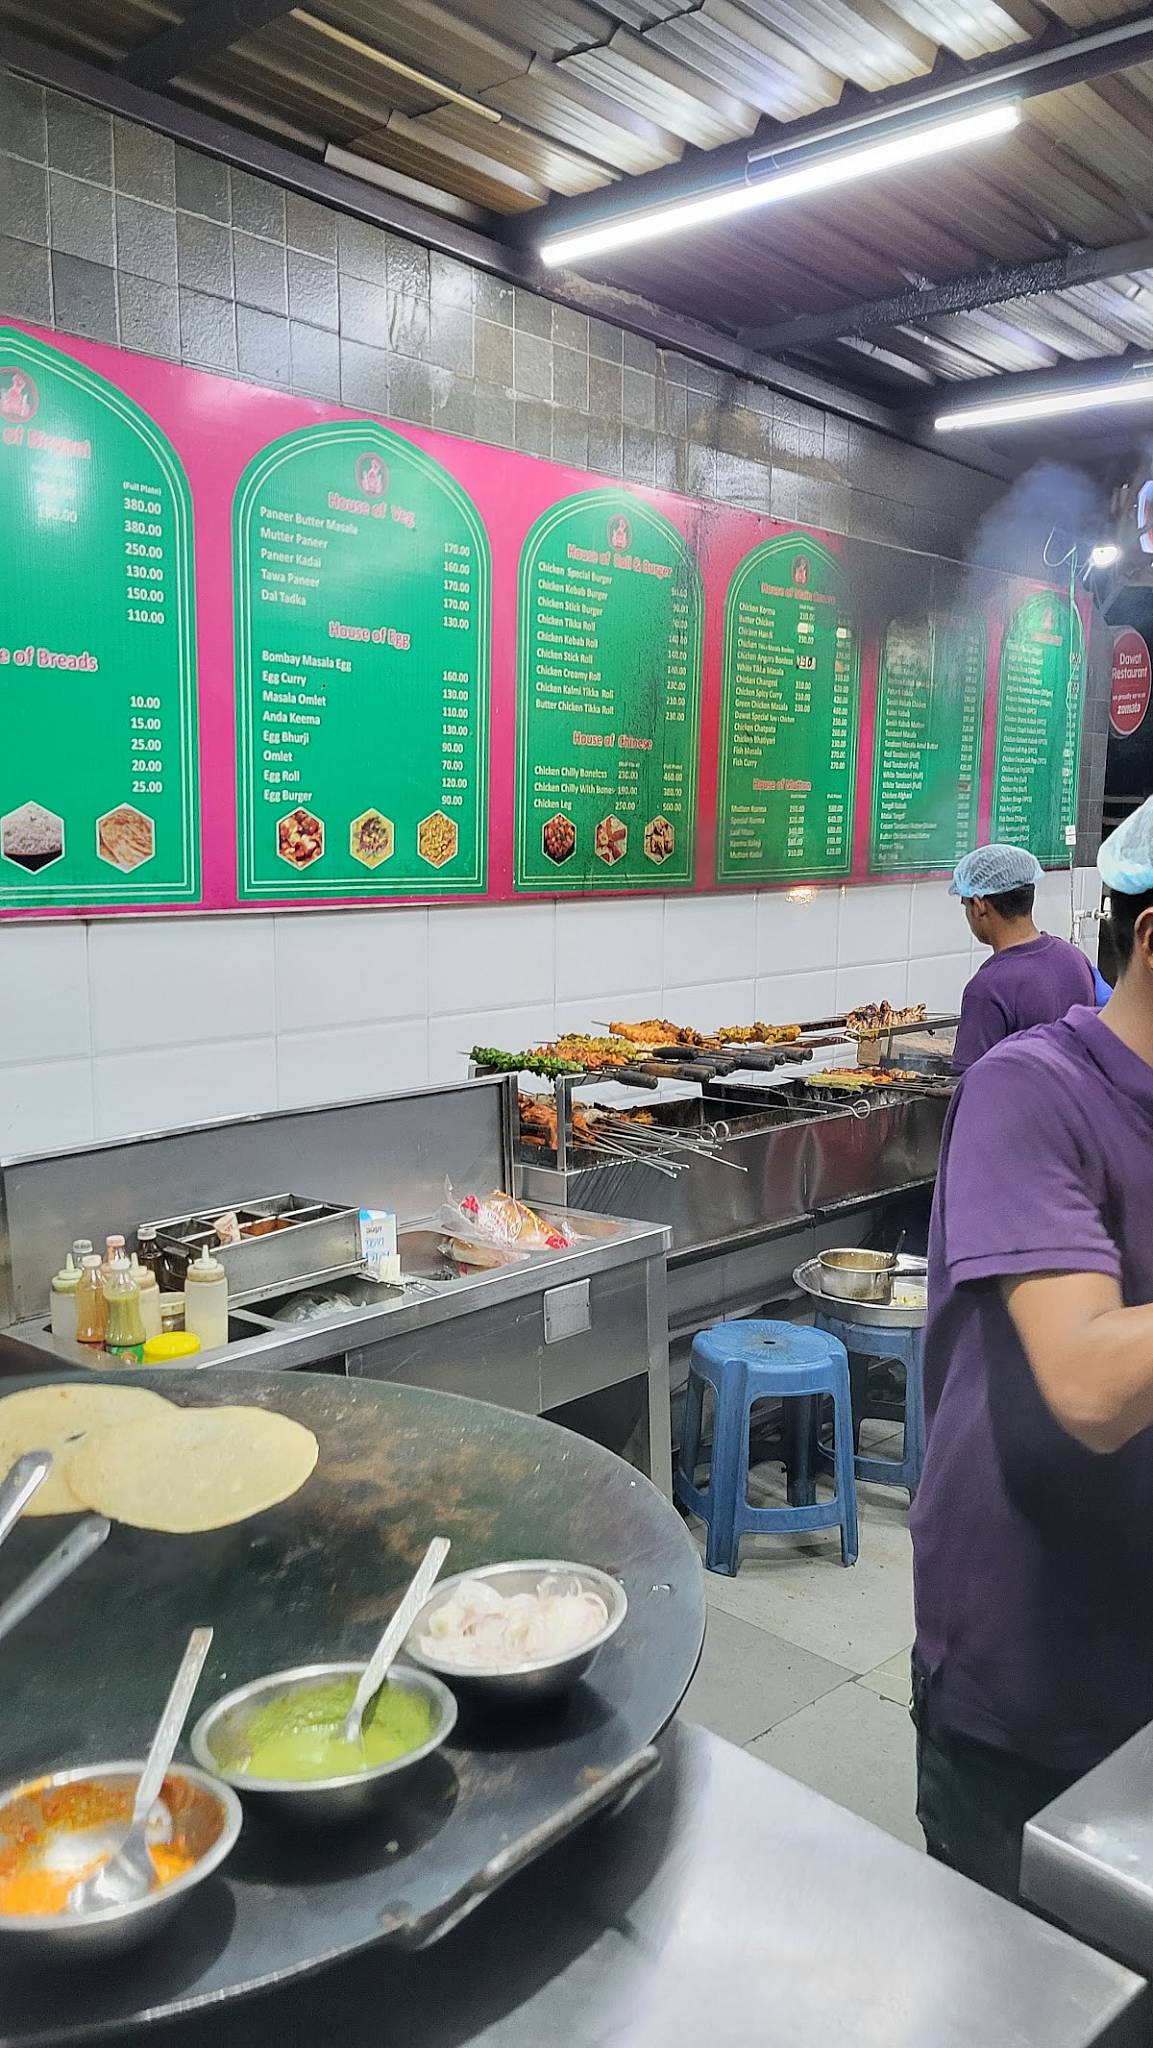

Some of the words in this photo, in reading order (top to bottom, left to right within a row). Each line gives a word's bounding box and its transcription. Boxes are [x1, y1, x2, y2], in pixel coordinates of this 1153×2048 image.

[123, 498, 161, 515] 380.00
[327, 491, 370, 516] House
[371, 503, 386, 518] of
[391, 505, 416, 529] Veg
[124, 520, 162, 536] 380.00
[260, 506, 294, 523] Paneer
[295, 512, 324, 529] Butter
[326, 517, 358, 535] Masala
[260, 527, 294, 545] Mutter
[296, 533, 328, 549] Paneer
[125, 542, 162, 559] 250.00
[443, 542, 470, 557] 170.00
[261, 548, 294, 564] Paneer
[295, 553, 322, 568] Kadai
[567, 543, 599, 564] House
[599, 551, 611, 566] of
[642, 558, 673, 580] Burger
[126, 564, 163, 580] 130.00
[444, 561, 470, 575] 160.00
[538, 561, 565, 575] Chicken
[567, 567, 591, 581] Special
[591, 571, 613, 585] Burger
[261, 568, 286, 583] Tawa
[288, 572, 320, 588] Paneer
[443, 579, 470, 593] 170.00
[127, 586, 164, 602] 150.00
[261, 589, 279, 601] Dal
[280, 591, 307, 606] Tadka
[538, 579, 564, 592] Chicken
[586, 588, 608, 601] Burger
[443, 598, 470, 612] 170.00
[537, 596, 564, 609] Chicken
[564, 601, 581, 613] Stick
[581, 603, 603, 617] Burger
[127, 608, 164, 624] 110.00
[443, 616, 469, 630] 130.00
[537, 614, 563, 627] Chicken
[564, 618, 582, 629] Tikka
[582, 621, 596, 632] Roll
[328, 621, 370, 642] House
[371, 628, 386, 644] of
[388, 629, 410, 649] Egg
[537, 631, 563, 644] Chicken
[585, 637, 599, 649] Roll
[13, 647, 34, 665] of
[37, 649, 98, 672] Breads
[262, 650, 301, 667] Bombay
[302, 655, 334, 669] Masala
[336, 658, 352, 672] Egg
[536, 648, 563, 661] Chicken
[563, 651, 580, 663] Stick
[580, 653, 593, 665] Roll
[1119, 652, 1142, 665] Dawat
[262, 671, 279, 685] Egg
[281, 673, 307, 687] Curry
[443, 671, 469, 684] 160.00
[536, 665, 562, 678] Chicken
[563, 668, 588, 681] Creamy
[589, 671, 602, 681] Roll
[1112, 666, 1147, 680] Restaurant
[263, 690, 297, 705] Masala
[298, 693, 326, 706] Omlet
[442, 689, 468, 701] 130.00
[536, 682, 562, 695] Chicken
[582, 687, 600, 698] Tikka
[601, 689, 614, 699] Roll
[130, 696, 160, 709] 10.00
[535, 699, 557, 710] Butter
[558, 701, 584, 713] Chicken
[584, 704, 601, 715] Tikka
[601, 706, 614, 715] Roll
[1117, 702, 1140, 715] zomato
[263, 711, 288, 723] Anda
[289, 712, 321, 725] Keema
[442, 706, 468, 719] 110.00
[131, 717, 161, 730] 15.00
[442, 724, 468, 736] 130.00
[131, 738, 161, 751] 25.00
[263, 730, 280, 744] Egg
[282, 731, 310, 746] Bhurji
[573, 730, 603, 747] House
[603, 733, 615, 747] of
[618, 735, 653, 751] Chinese
[442, 742, 464, 754] 90.00
[263, 750, 293, 763] Omlet
[131, 760, 162, 772] 20.00
[442, 760, 464, 771] 70.00
[534, 765, 560, 777] Chicken
[561, 767, 579, 778] Chilly
[579, 768, 608, 779] Boneless
[263, 769, 280, 783] Egg
[282, 770, 300, 782] Roll
[442, 777, 467, 789] 120.00
[132, 780, 163, 793] 25.00
[534, 782, 560, 793] Chicken
[561, 783, 579, 795] Chilly
[579, 784, 596, 795] With
[263, 789, 280, 803] Egg
[282, 789, 313, 803] Burger
[441, 795, 463, 806] 90.00
[534, 799, 560, 810] Chicken
[560, 801, 572, 812] Leg
